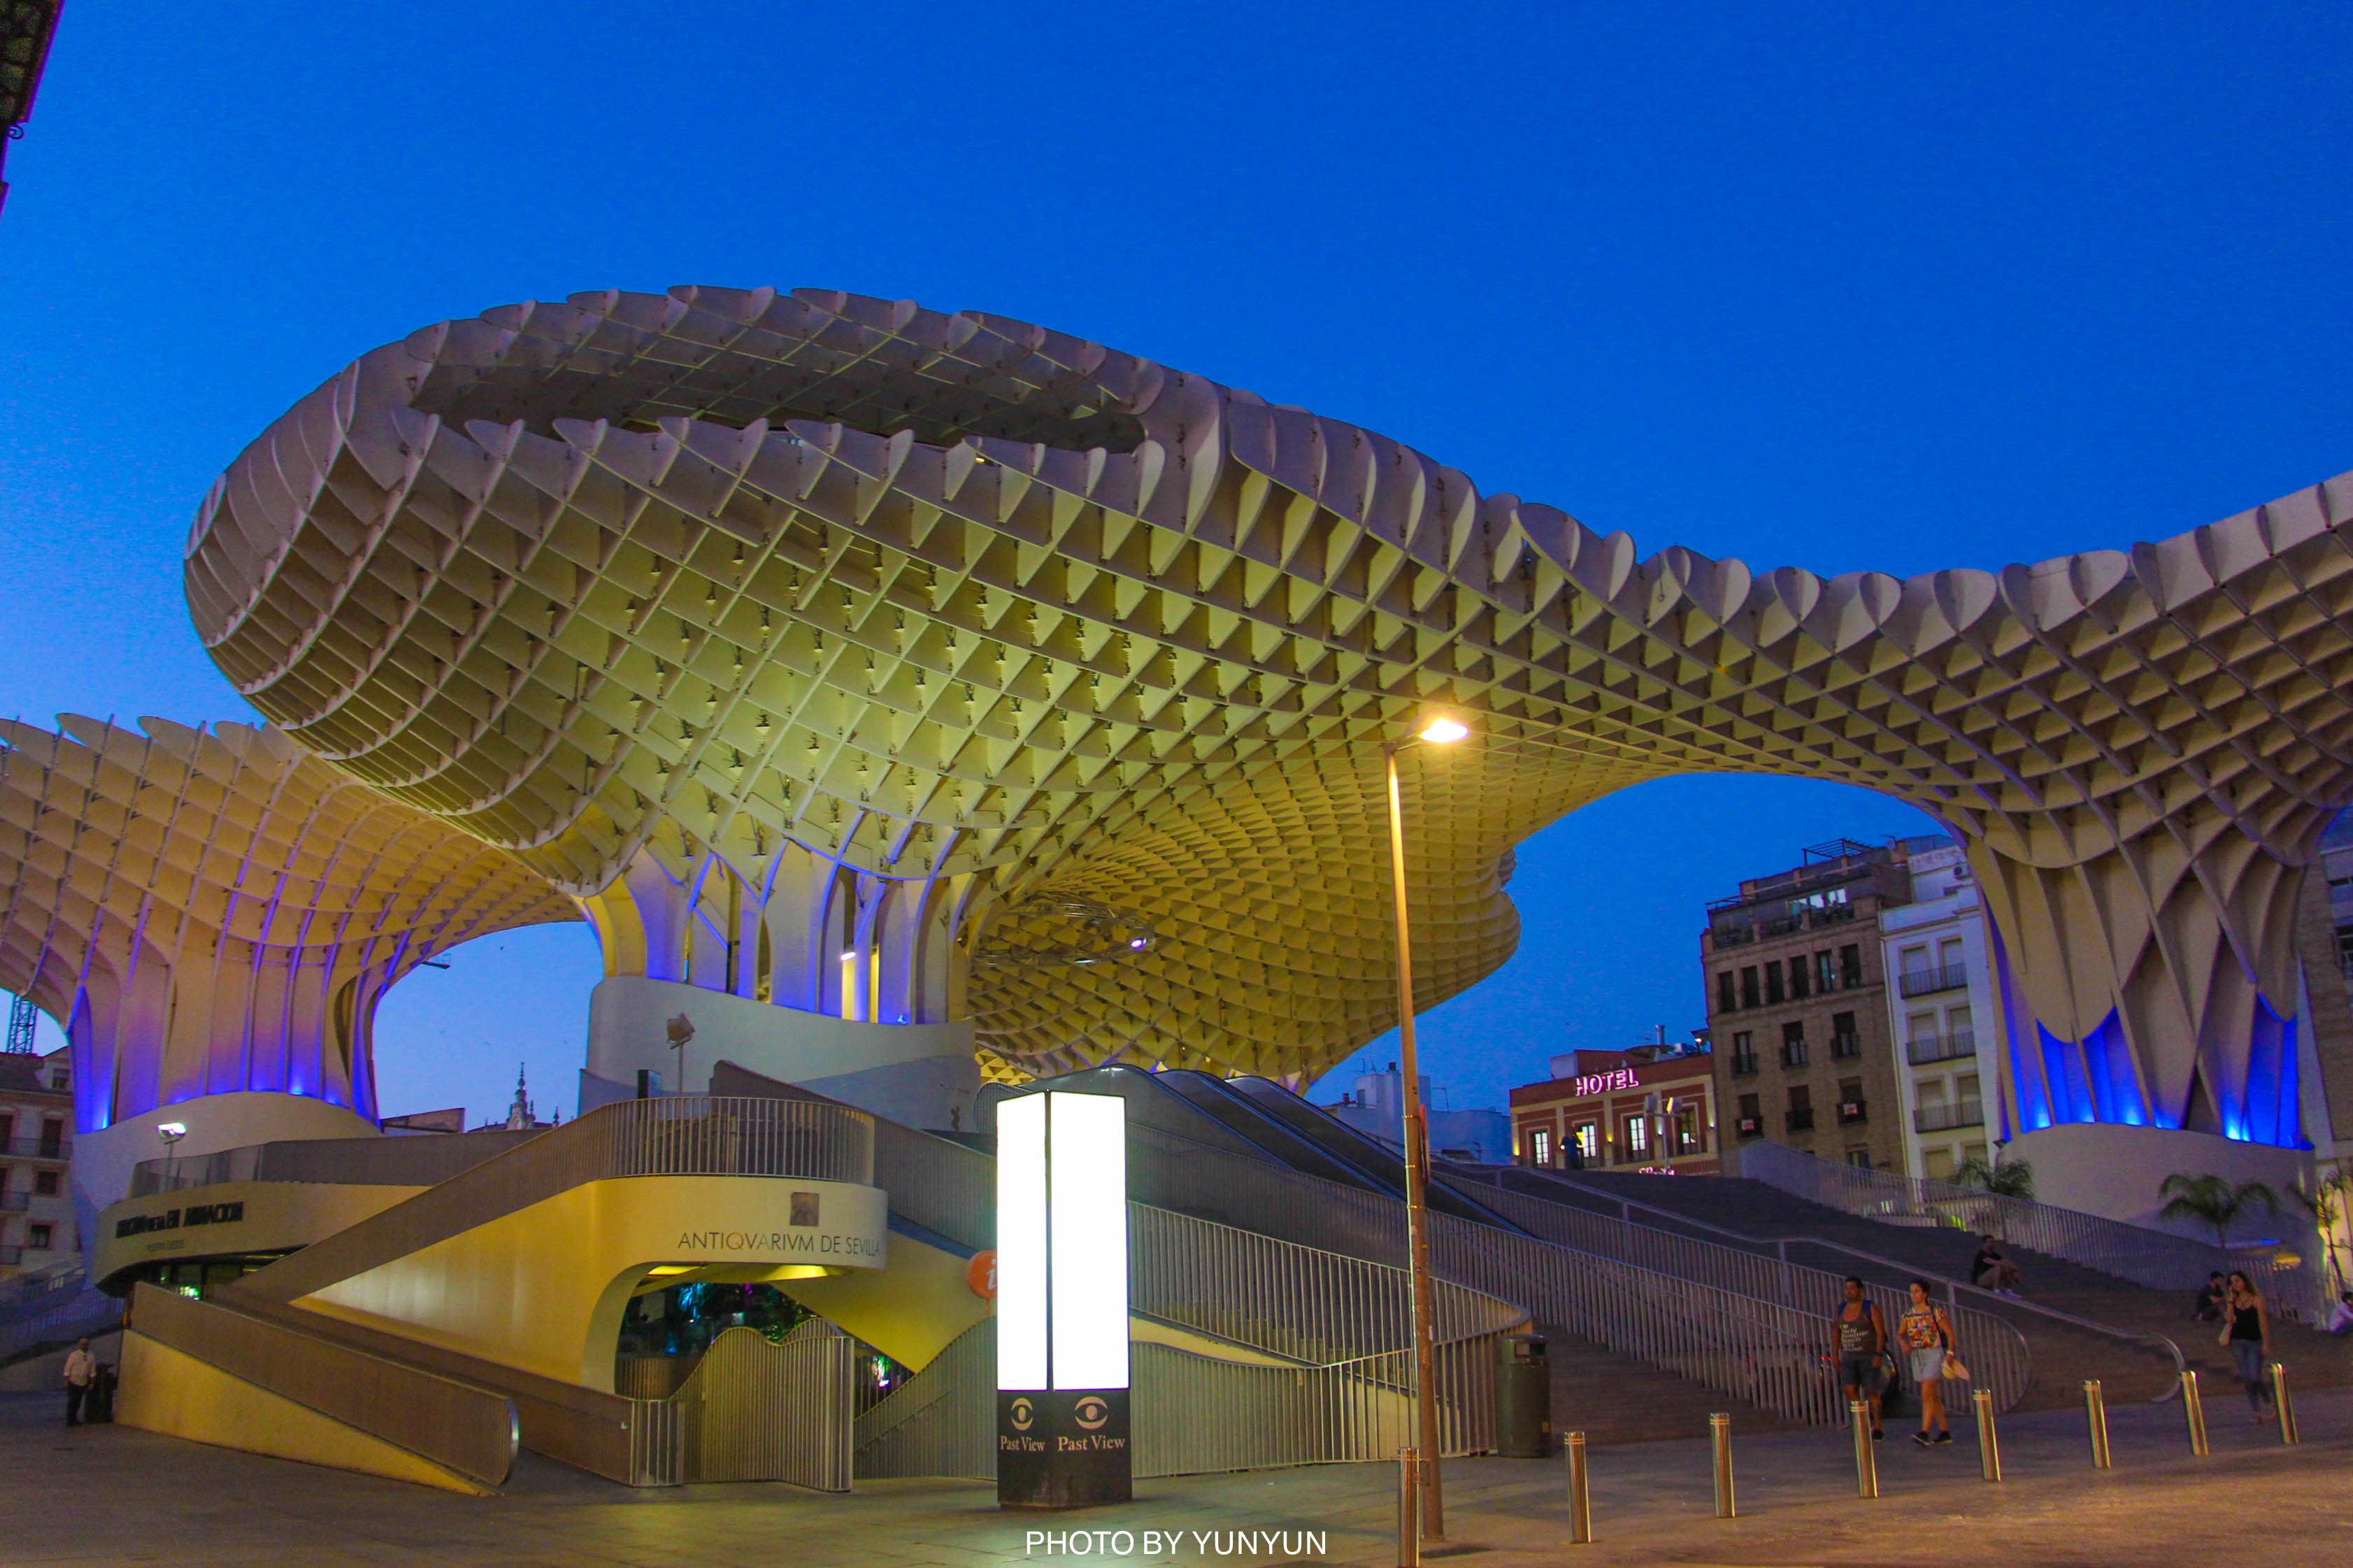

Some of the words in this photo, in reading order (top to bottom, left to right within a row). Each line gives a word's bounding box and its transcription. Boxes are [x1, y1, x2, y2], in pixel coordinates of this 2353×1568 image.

[1575, 1068, 1639, 1096] HOTEL
[678, 1231, 814, 1252] ANTIQVARIVM
[821, 1235, 841, 1253] DE
[845, 1237, 879, 1257] SEVILLA
[1000, 1435, 1020, 1451] Past
[1021, 1437, 1045, 1452] View
[1057, 1436, 1087, 1452] Past
[1091, 1434, 1126, 1449] View
